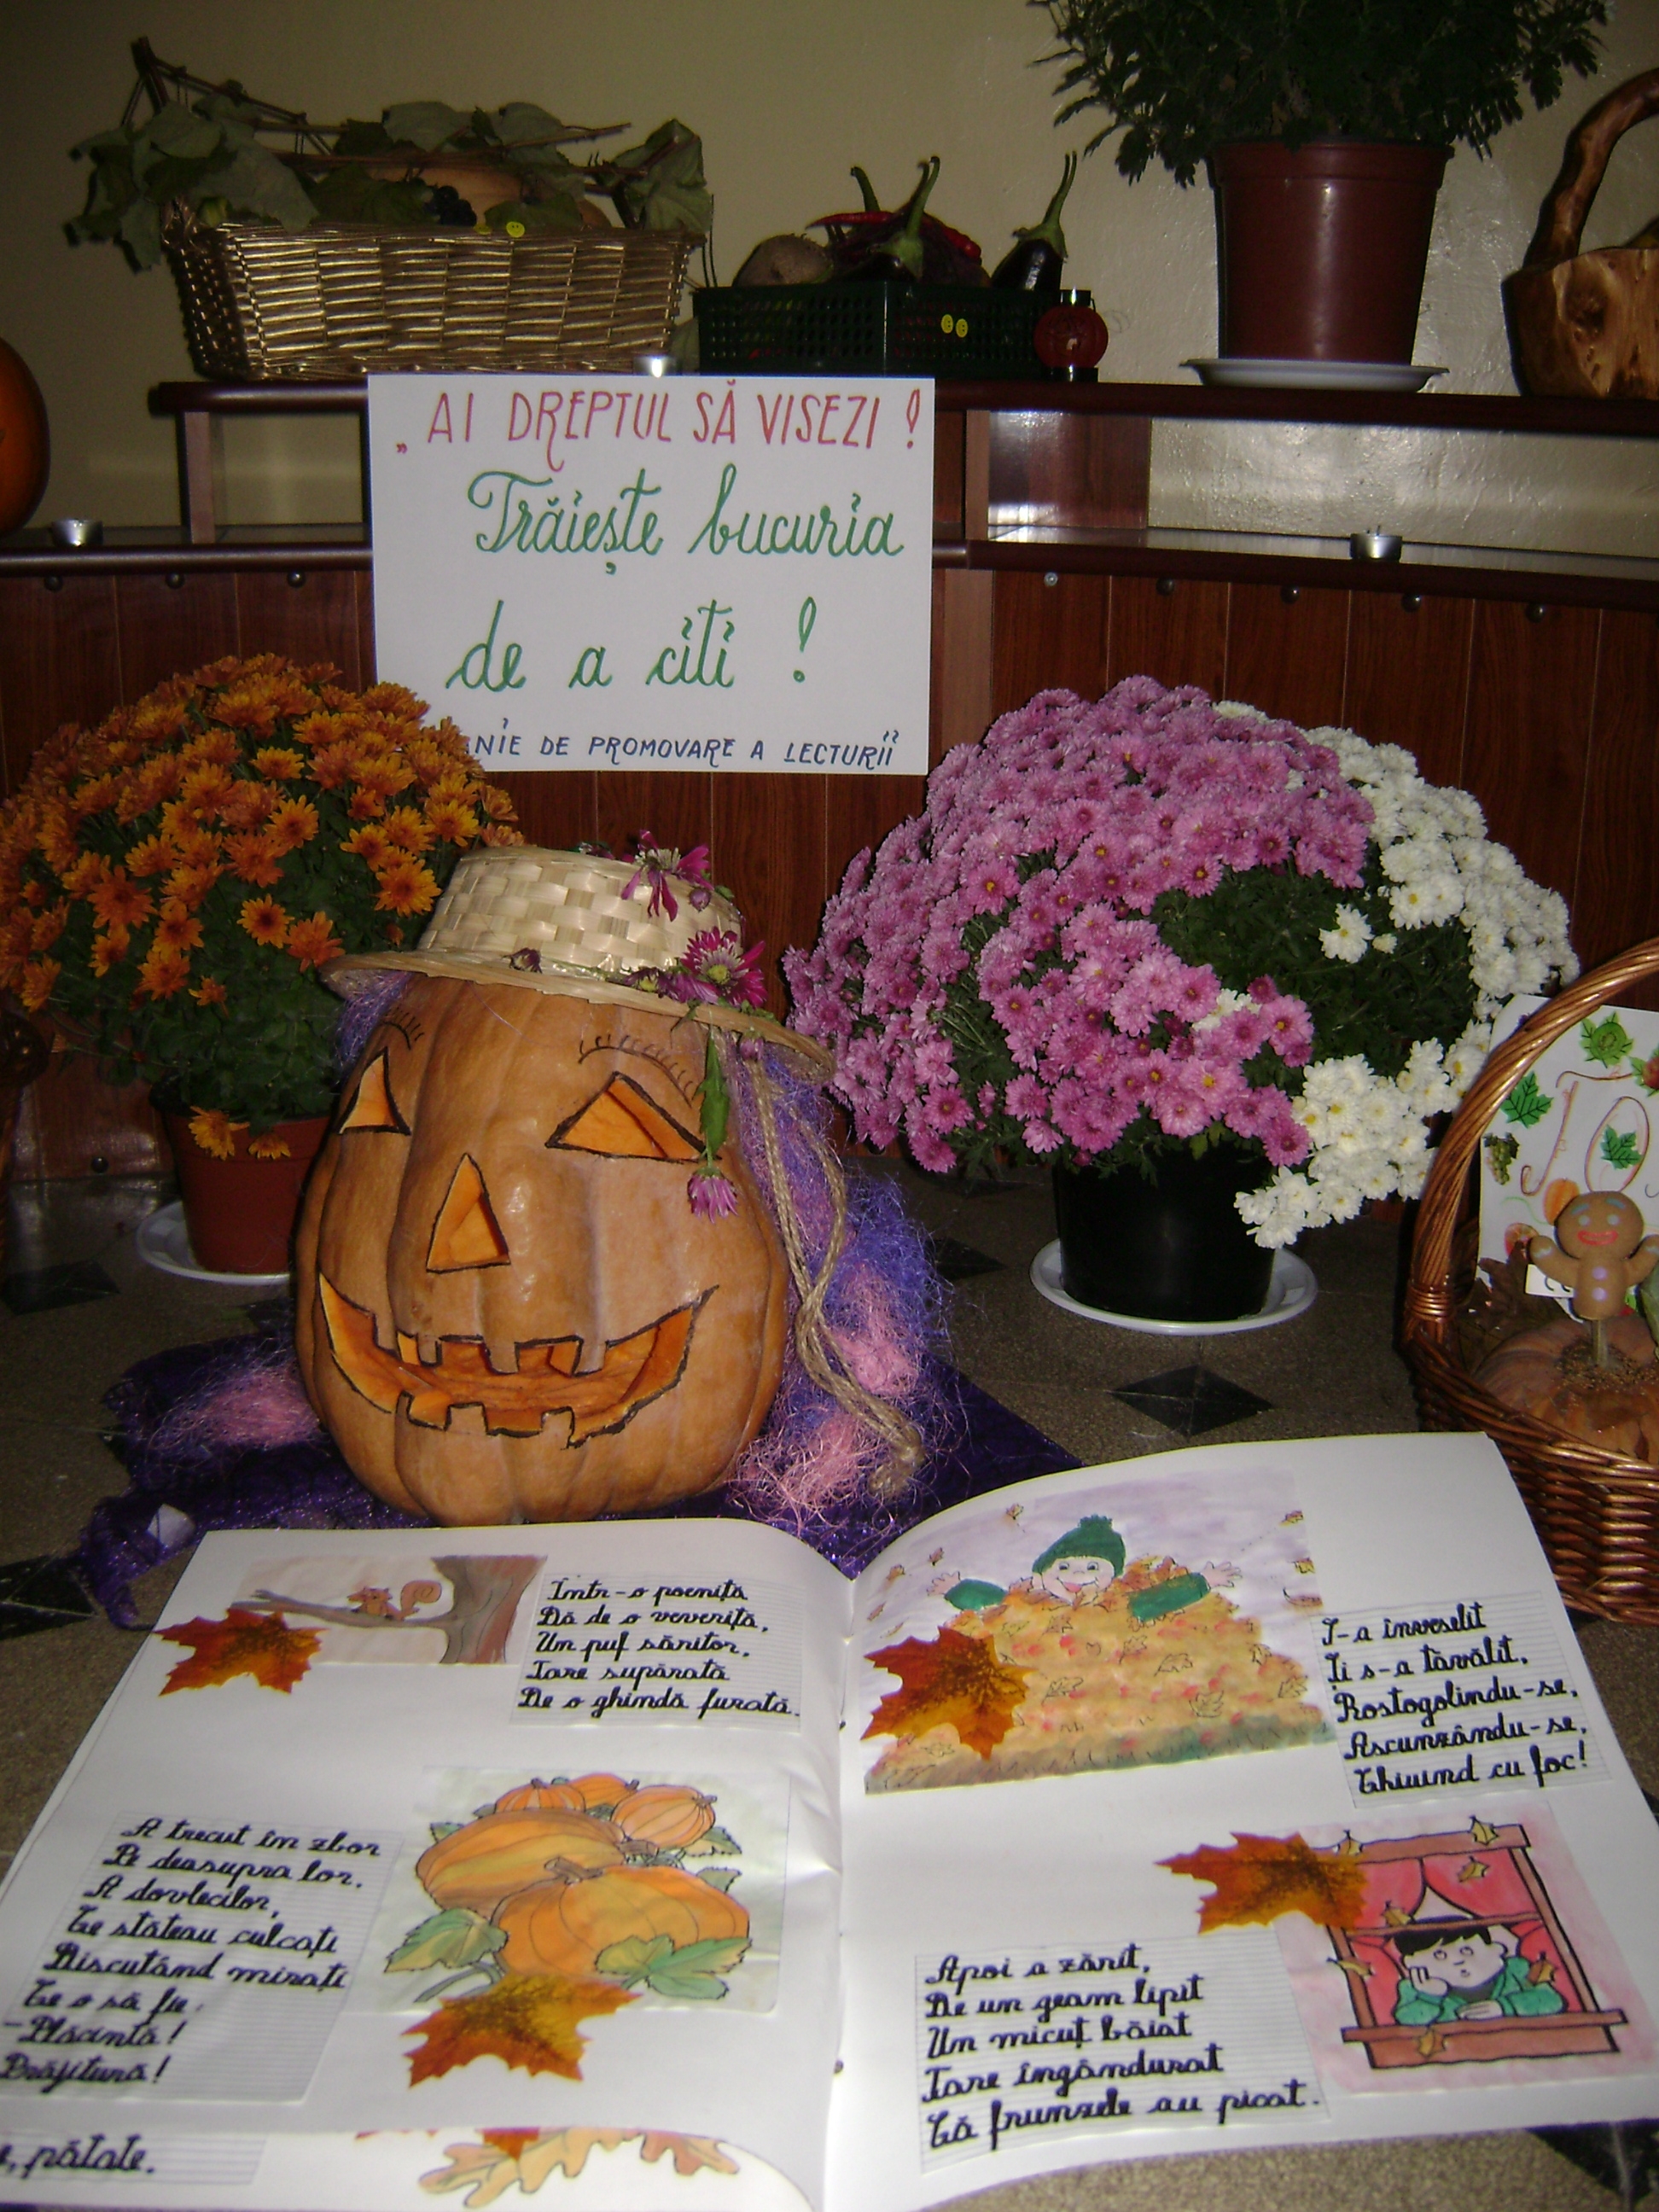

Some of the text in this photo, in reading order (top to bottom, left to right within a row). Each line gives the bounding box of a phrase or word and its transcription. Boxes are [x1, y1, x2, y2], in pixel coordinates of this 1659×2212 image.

[509, 390, 672, 472] DREPTUL
[693, 380, 736, 445] SĂ
[757, 393, 880, 450] VISEZI
[687, 463, 904, 556] bucuria
[446, 600, 527, 691] de
[569, 644, 613, 688] a
[646, 600, 735, 687] citi
[467, 718, 899, 767] NIE DE PROMOVARE A LECTURII
[537, 1606, 578, 1627] Dă
[584, 1604, 611, 1626] de
[619, 1614, 642, 1626] o
[535, 1630, 577, 1653] Un
[580, 1631, 629, 1662] puf
[599, 1659, 731, 1691] supărată
[1360, 1660, 1414, 1680] s-a
[517, 1685, 800, 1720] De o ghindă furată.
[1487, 1761, 1526, 1779] cu
[1529, 1739, 1587, 1788] foc!
[120, 1817, 381, 1858] A trecut în zbor
[83, 1873, 124, 1900] A
[102, 1842, 363, 1889] Pe deasupra lor.
[109, 1910, 218, 1945] stăteau
[924, 1954, 1014, 1996] Apoi
[1023, 1962, 1049, 1976] a
[68, 1994, 93, 2008] o
[98, 1992, 141, 2011] să
[925, 1974, 1203, 2023] De un geam lipit
[927, 2026, 978, 2060] Un
[1101, 2011, 1192, 2041] băiat
[921, 2042, 1224, 2103] Tare îngândurat
[990, 2087, 1132, 2151] frunzele
[1147, 2096, 1203, 2114] au
[1214, 2078, 1320, 2126] picat.
